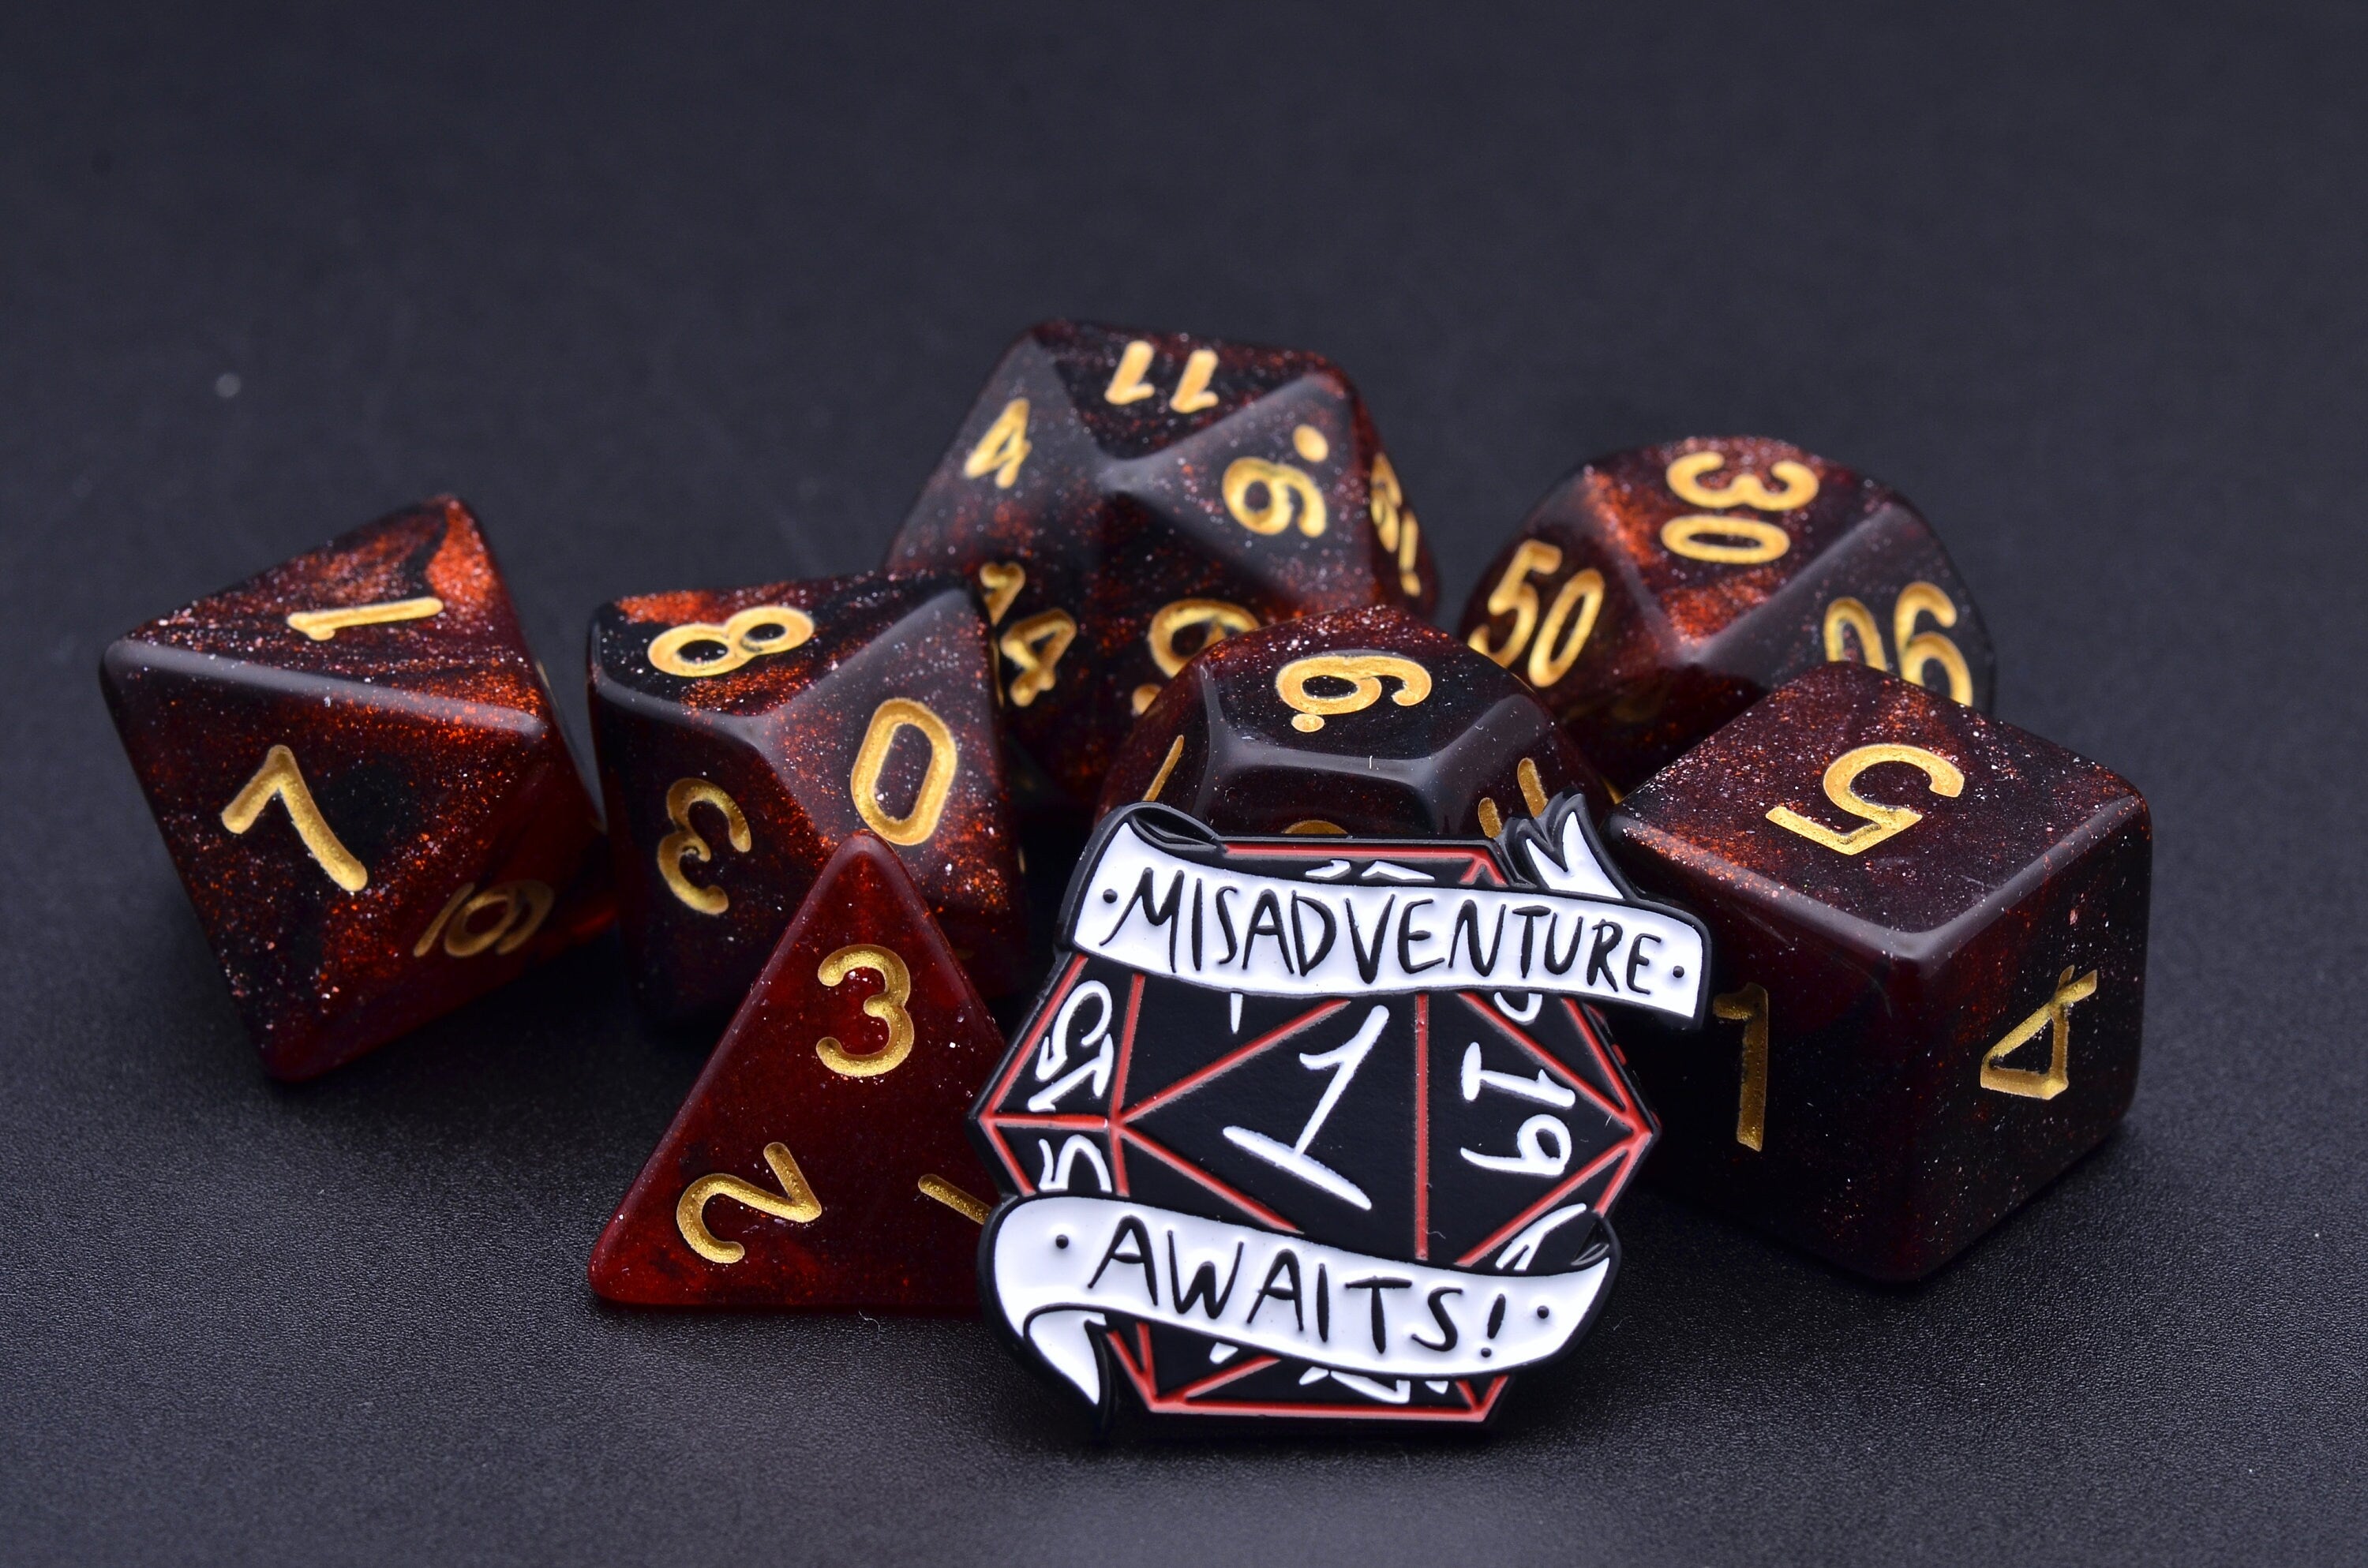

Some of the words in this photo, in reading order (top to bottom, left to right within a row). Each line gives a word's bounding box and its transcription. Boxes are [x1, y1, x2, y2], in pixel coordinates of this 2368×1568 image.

[964, 398, 1031, 489] 4
[1105, 340, 1220, 414] 11
[1661, 451, 1819, 565] 30
[285, 597, 444, 642] 1
[647, 604, 815, 679] 8
[1468, 538, 1605, 688] 50
[220, 744, 368, 892] 7
[850, 698, 957, 846] 0
[1765, 743, 1965, 856] 5
[657, 777, 752, 915] 3
[1100, 866, 1664, 995] MISADVENTURE
[815, 944, 914, 1078] 3
[1713, 982, 1769, 1152] 1
[1980, 964, 2098, 1101] 4
[1223, 1005, 1390, 1211] 1
[1460, 1041, 1576, 1177] 19
[676, 1142, 822, 1264] 2
[1087, 1214, 1507, 1359] AWAITS!
